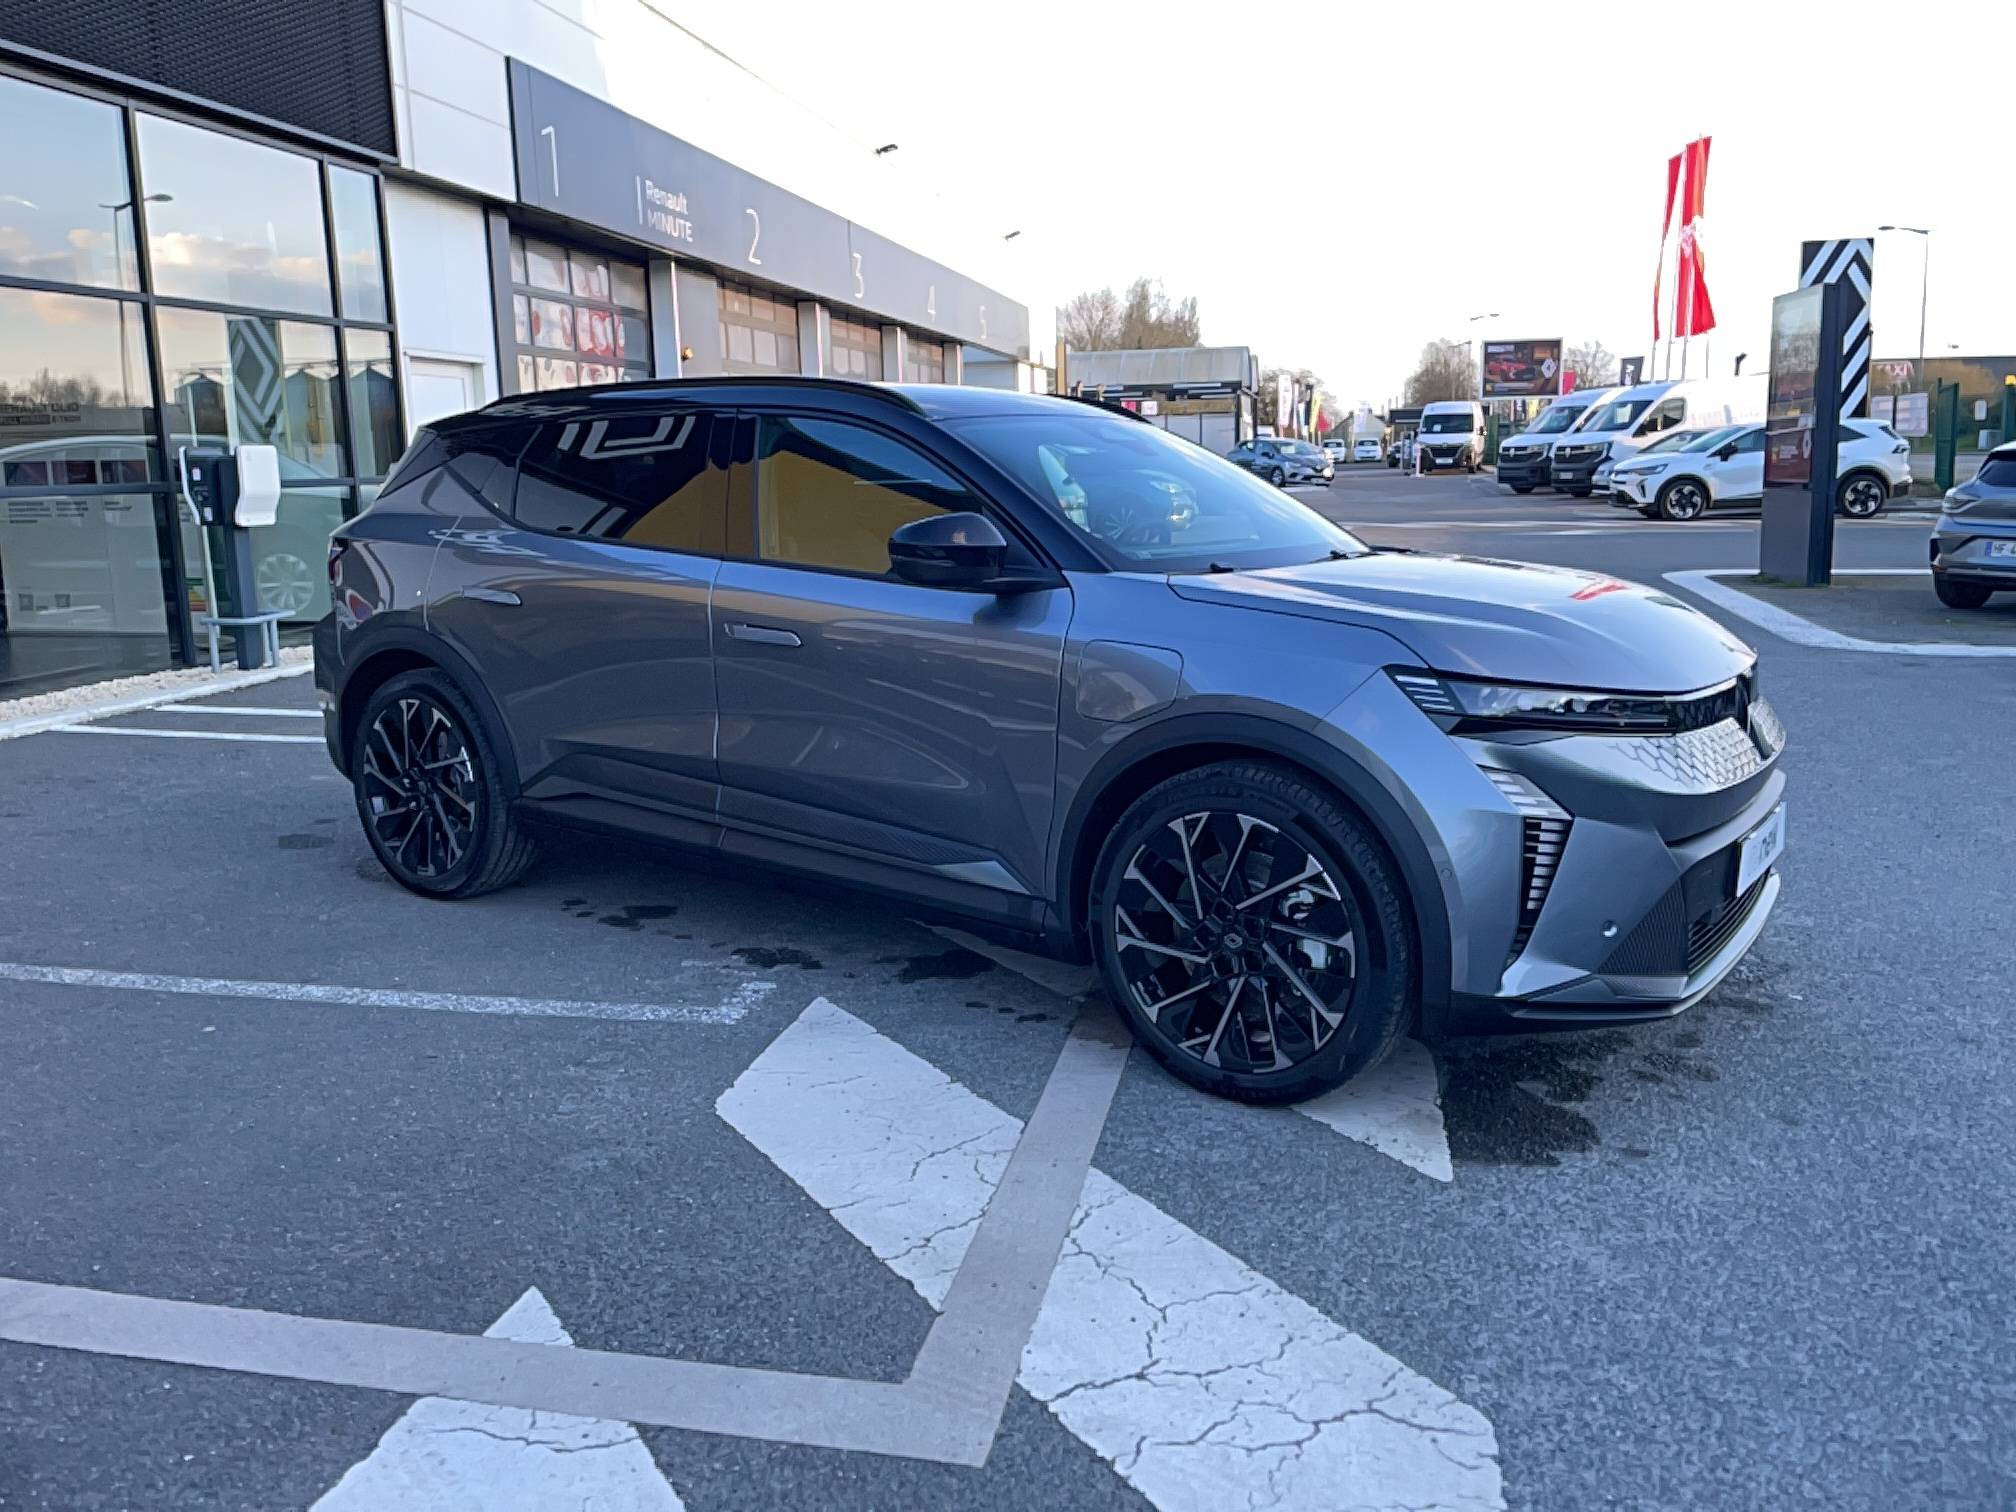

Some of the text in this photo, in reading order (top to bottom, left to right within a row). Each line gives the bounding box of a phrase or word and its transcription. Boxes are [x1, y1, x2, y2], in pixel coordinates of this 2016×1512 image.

[541, 126, 559, 197] 1
[645, 180, 689, 215] Renault
[647, 208, 694, 243] MINUTE
[746, 208, 762, 265] 2
[852, 252, 865, 299] 3
[927, 285, 937, 322] 4
[979, 304, 988, 339] 5
